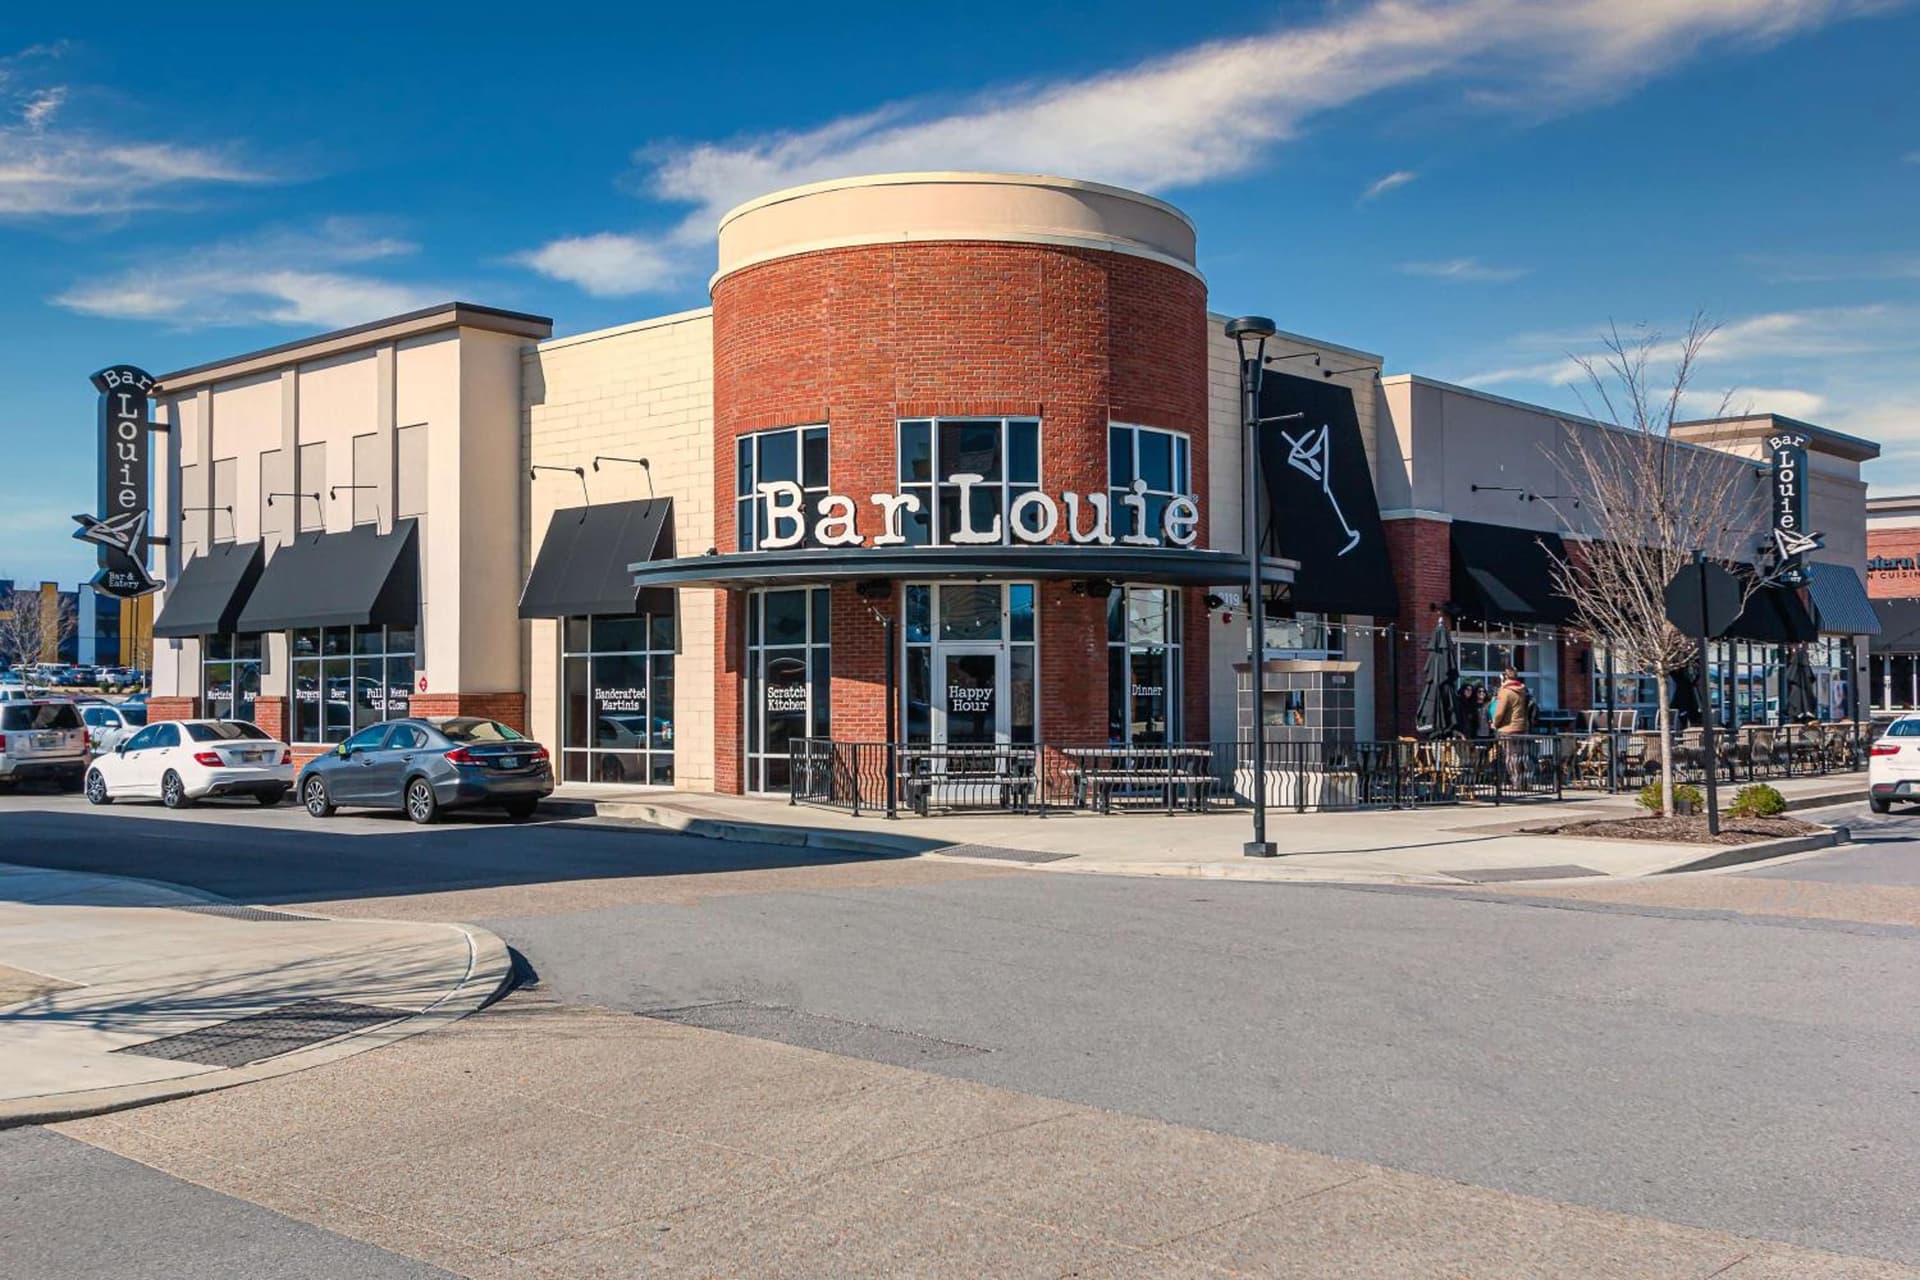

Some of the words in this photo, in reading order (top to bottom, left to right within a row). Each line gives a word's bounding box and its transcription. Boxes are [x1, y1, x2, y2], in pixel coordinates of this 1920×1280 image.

[103, 369, 152, 390] Bar
[1769, 435, 1804, 450] Bar
[117, 393, 138, 508] Louie
[1779, 451, 1795, 528] Louie
[757, 480, 920, 550] Bar
[948, 473, 1199, 546] Louie
[108, 571, 126, 580] Bar
[108, 579, 139, 589] Eatery
[330, 689, 346, 699] Beer
[366, 688, 384, 699] Full
[390, 688, 408, 698] Menu
[594, 688, 646, 699] Handcrafted
[767, 686, 807, 698] Scratch
[949, 685, 993, 701] Happy
[1131, 684, 1163, 696] Dinner
[388, 699, 408, 710] Close
[602, 700, 639, 710] Martinis
[768, 699, 807, 711] Kitchen
[953, 699, 989, 711] Hour
